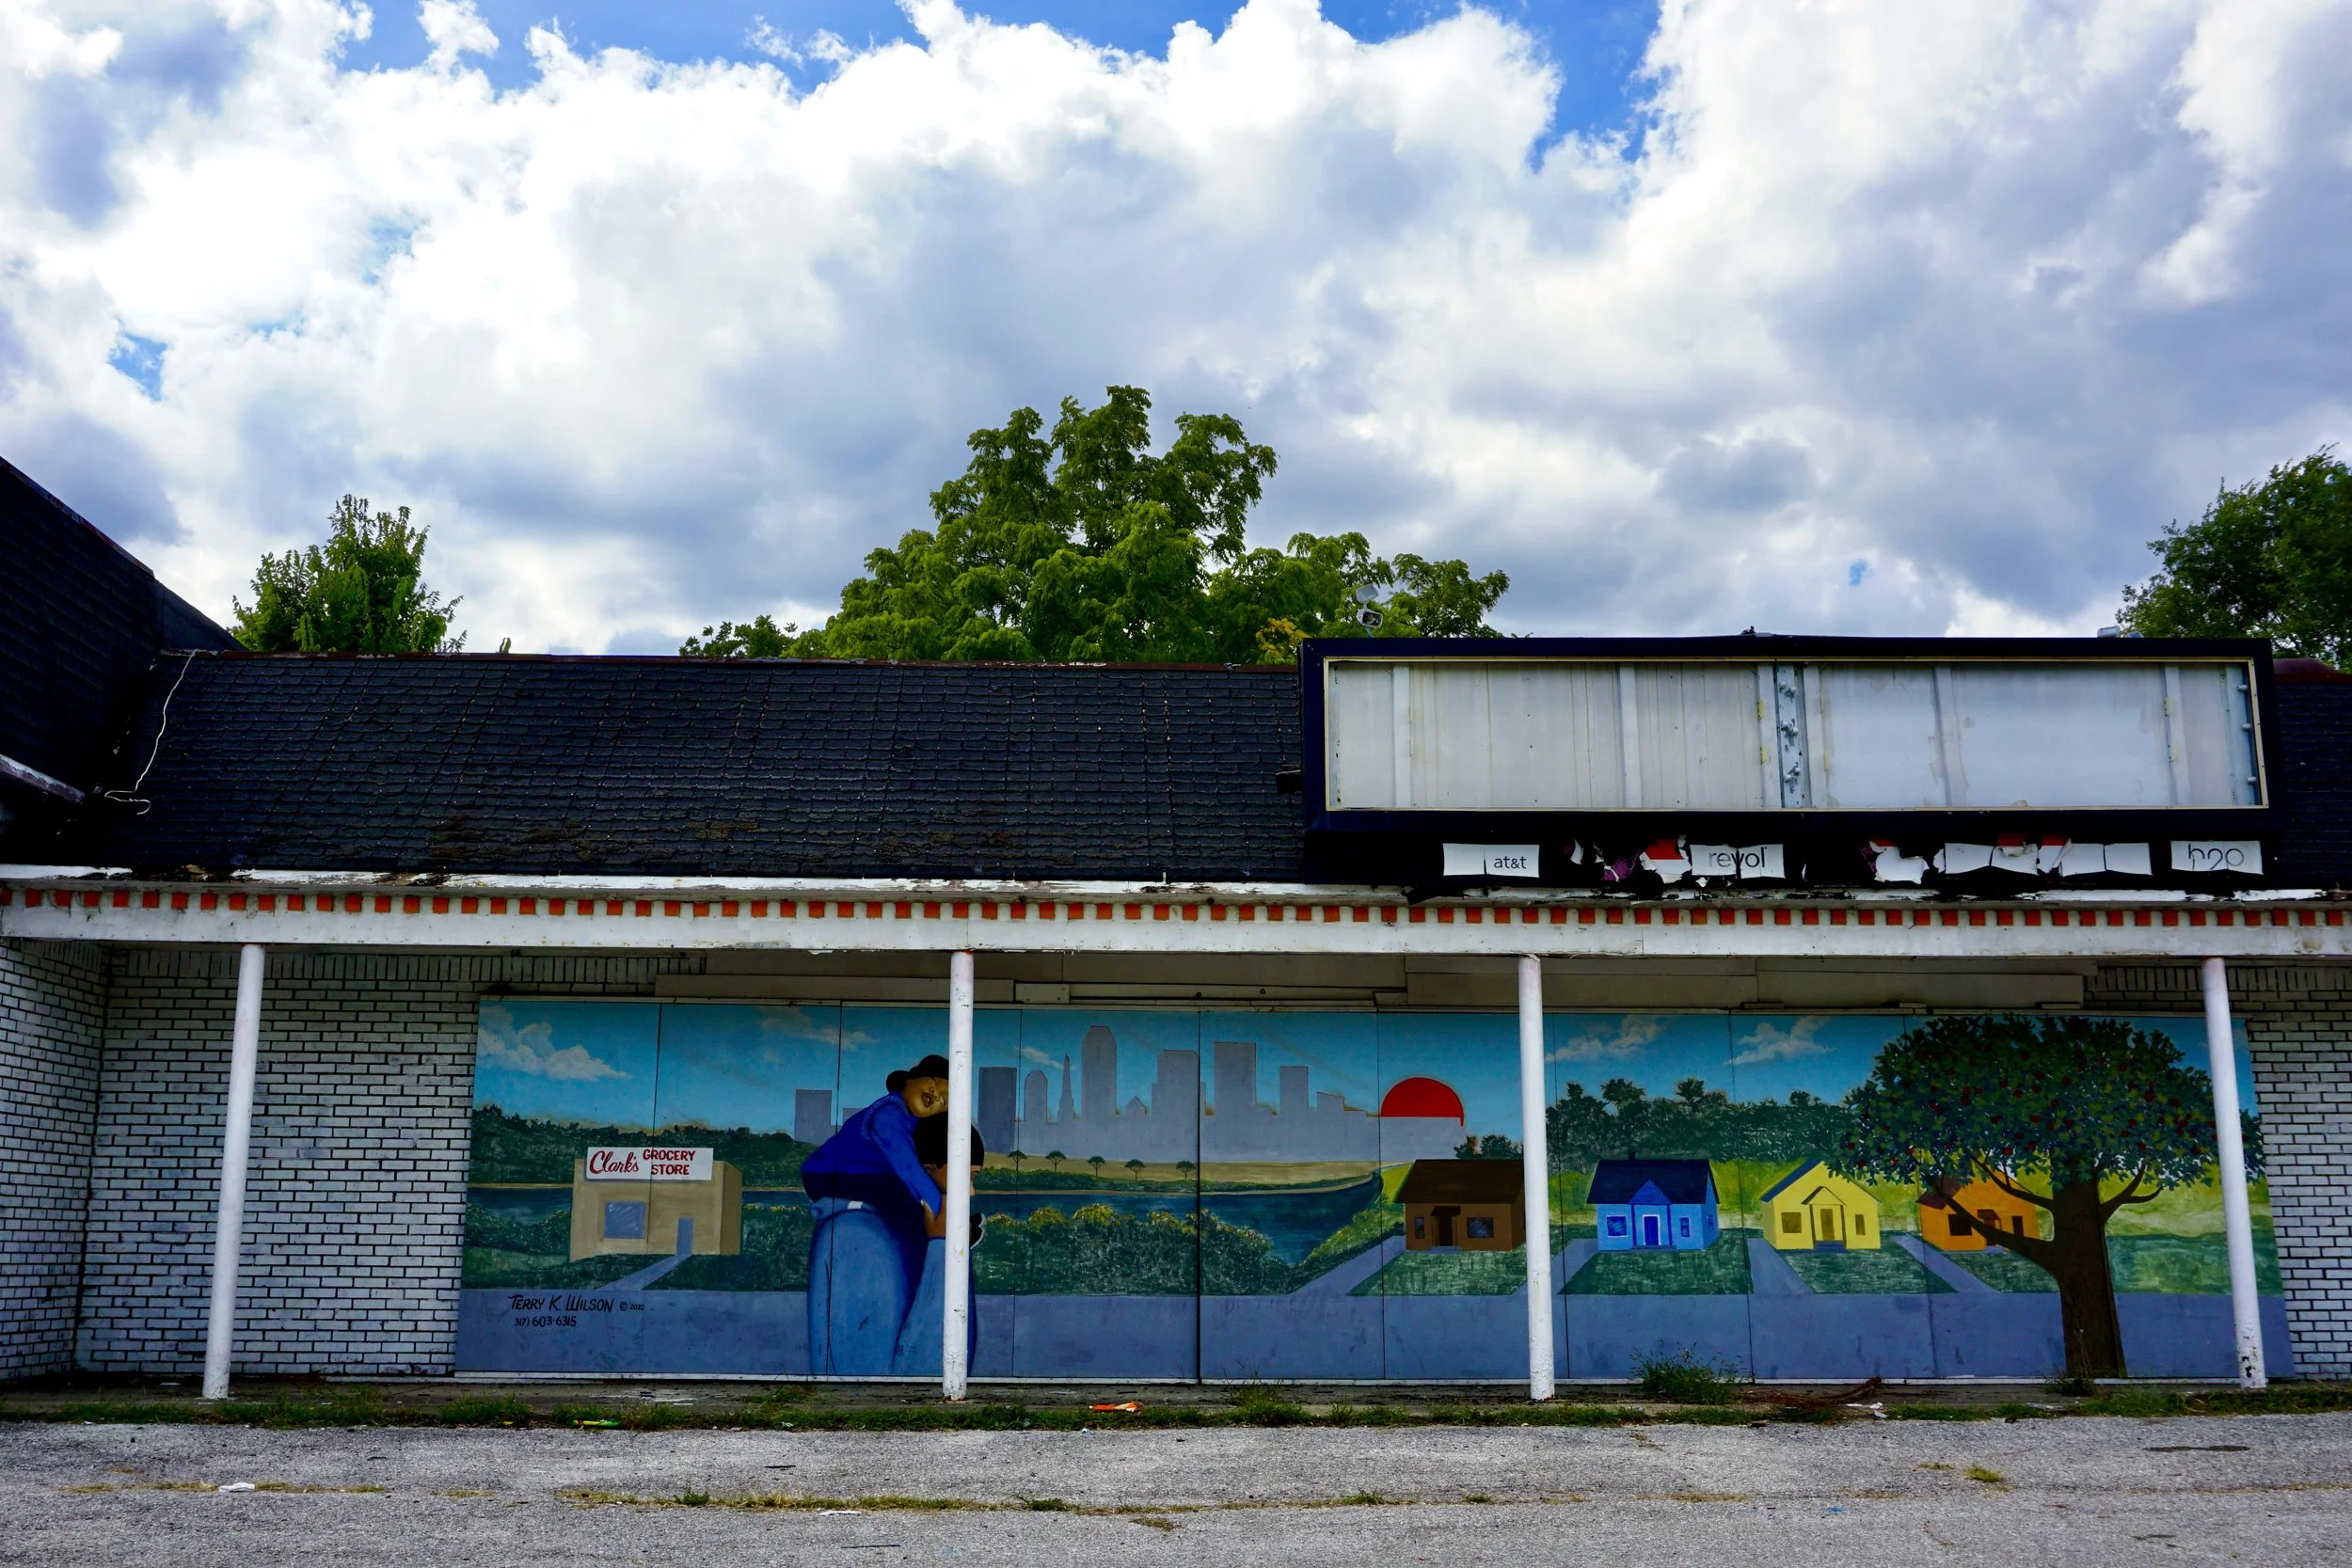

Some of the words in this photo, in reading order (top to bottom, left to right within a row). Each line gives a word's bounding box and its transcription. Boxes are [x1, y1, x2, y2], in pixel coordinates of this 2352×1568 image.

[1493, 855, 1527, 869] at&t
[1708, 847, 1766, 867] revol
[589, 1150, 639, 1175] Clark's
[642, 1148, 696, 1162] GROCERY
[650, 1164, 690, 1175] STORE
[507, 1294, 546, 1310] TERRY
[564, 1294, 614, 1313] WILSON
[532, 1316, 578, 1327] 603-6315
